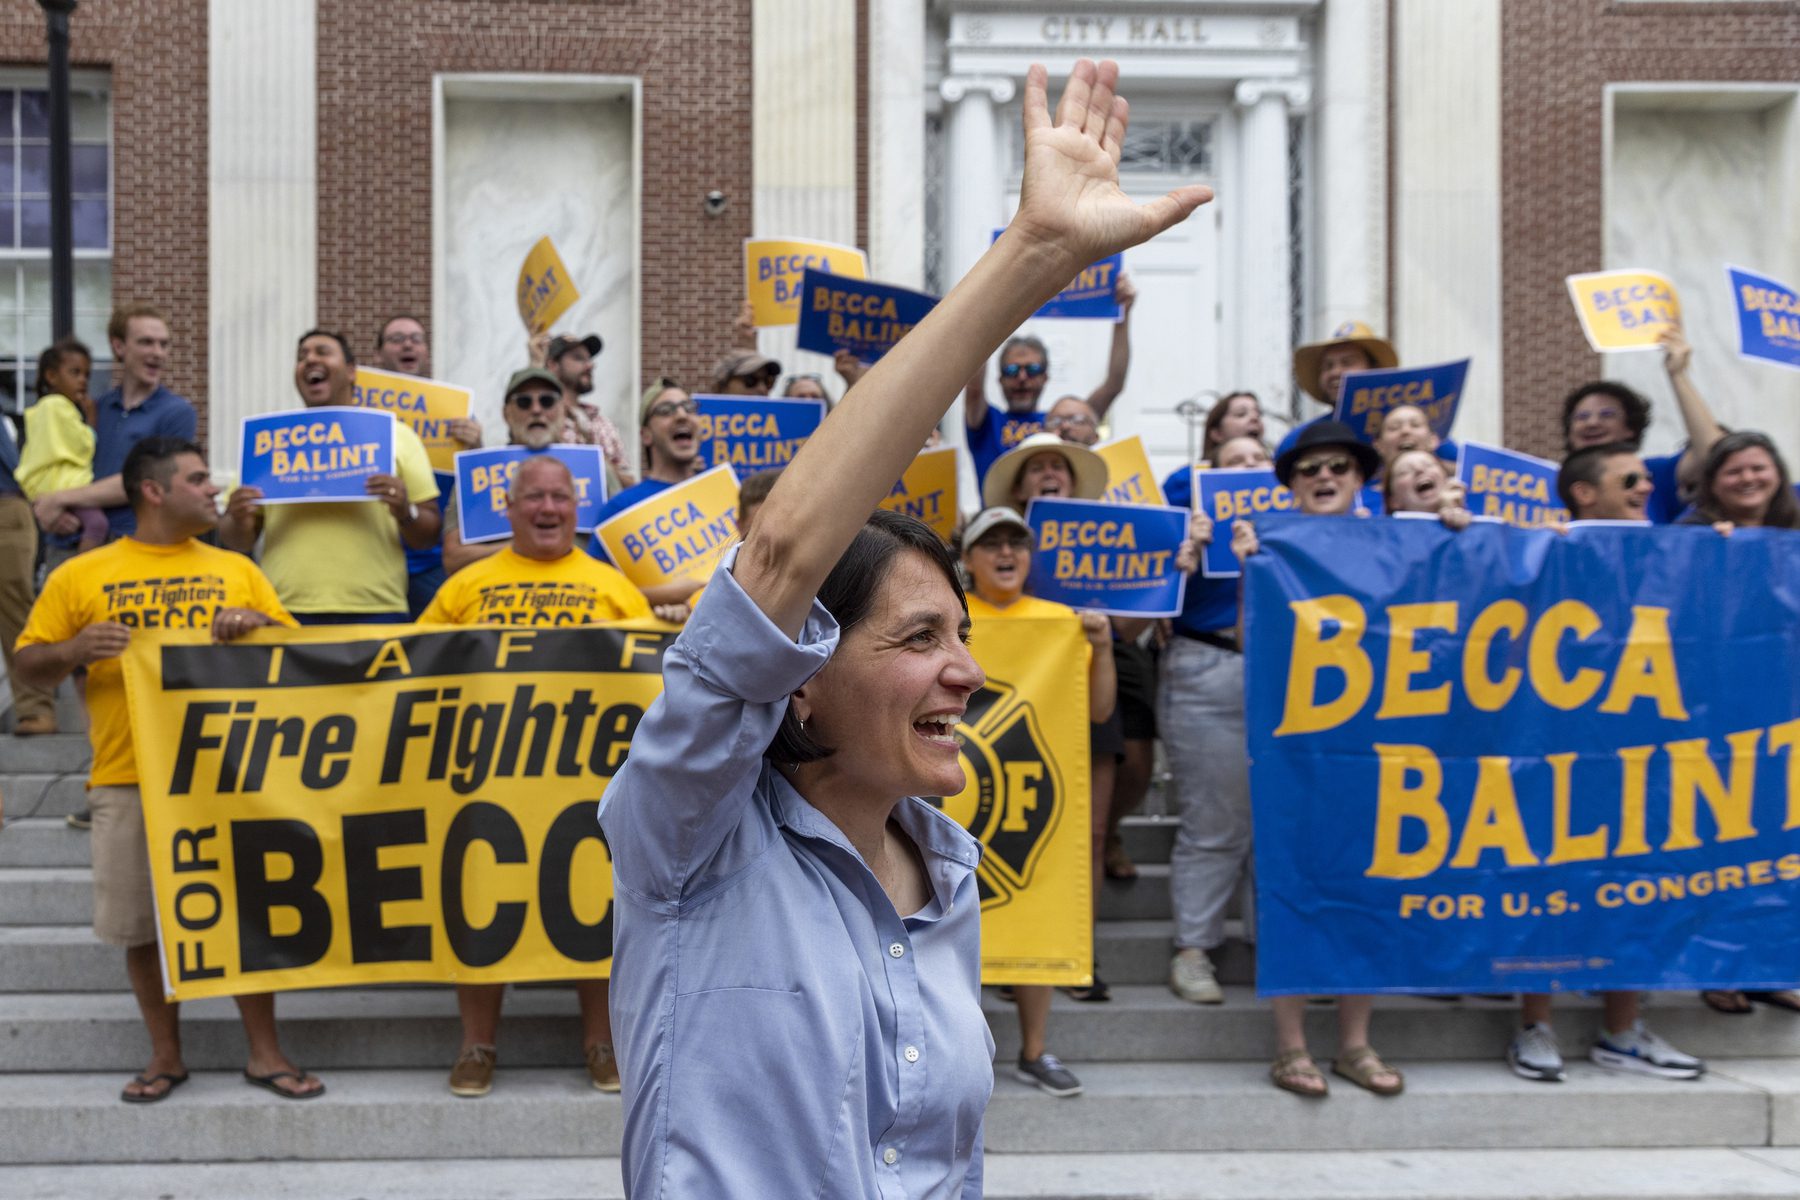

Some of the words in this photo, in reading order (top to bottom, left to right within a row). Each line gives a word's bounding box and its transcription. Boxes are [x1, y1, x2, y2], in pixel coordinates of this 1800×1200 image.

[1041, 16, 1113, 42] CITY
[1128, 16, 1209, 43] HALL
[813, 286, 898, 319] BECCA
[827, 311, 915, 343] BALIN
[352, 384, 428, 416] BECCA
[1352, 378, 1434, 417] BECCA
[254, 421, 346, 457] BECCA
[700, 413, 780, 442] BECCA
[271, 442, 380, 477] BALINT
[1471, 463, 1550, 503] BECCA
[622, 500, 705, 564] BECCA
[652, 506, 738, 575] BALINT
[1039, 518, 1137, 551] BECCA
[1055, 549, 1172, 580] BALINT
[108, 590, 145, 611] Fire
[152, 585, 226, 610] Fighters
[520, 591, 597, 610] Fighters
[1273, 594, 1690, 738] BECCA
[169, 700, 358, 795] Fire
[380, 684, 646, 795] Fighte
[1002, 760, 1043, 832] F
[172, 824, 226, 983] FOR
[1400, 894, 1485, 920] FOR
[1501, 890, 1580, 917] U.S.
